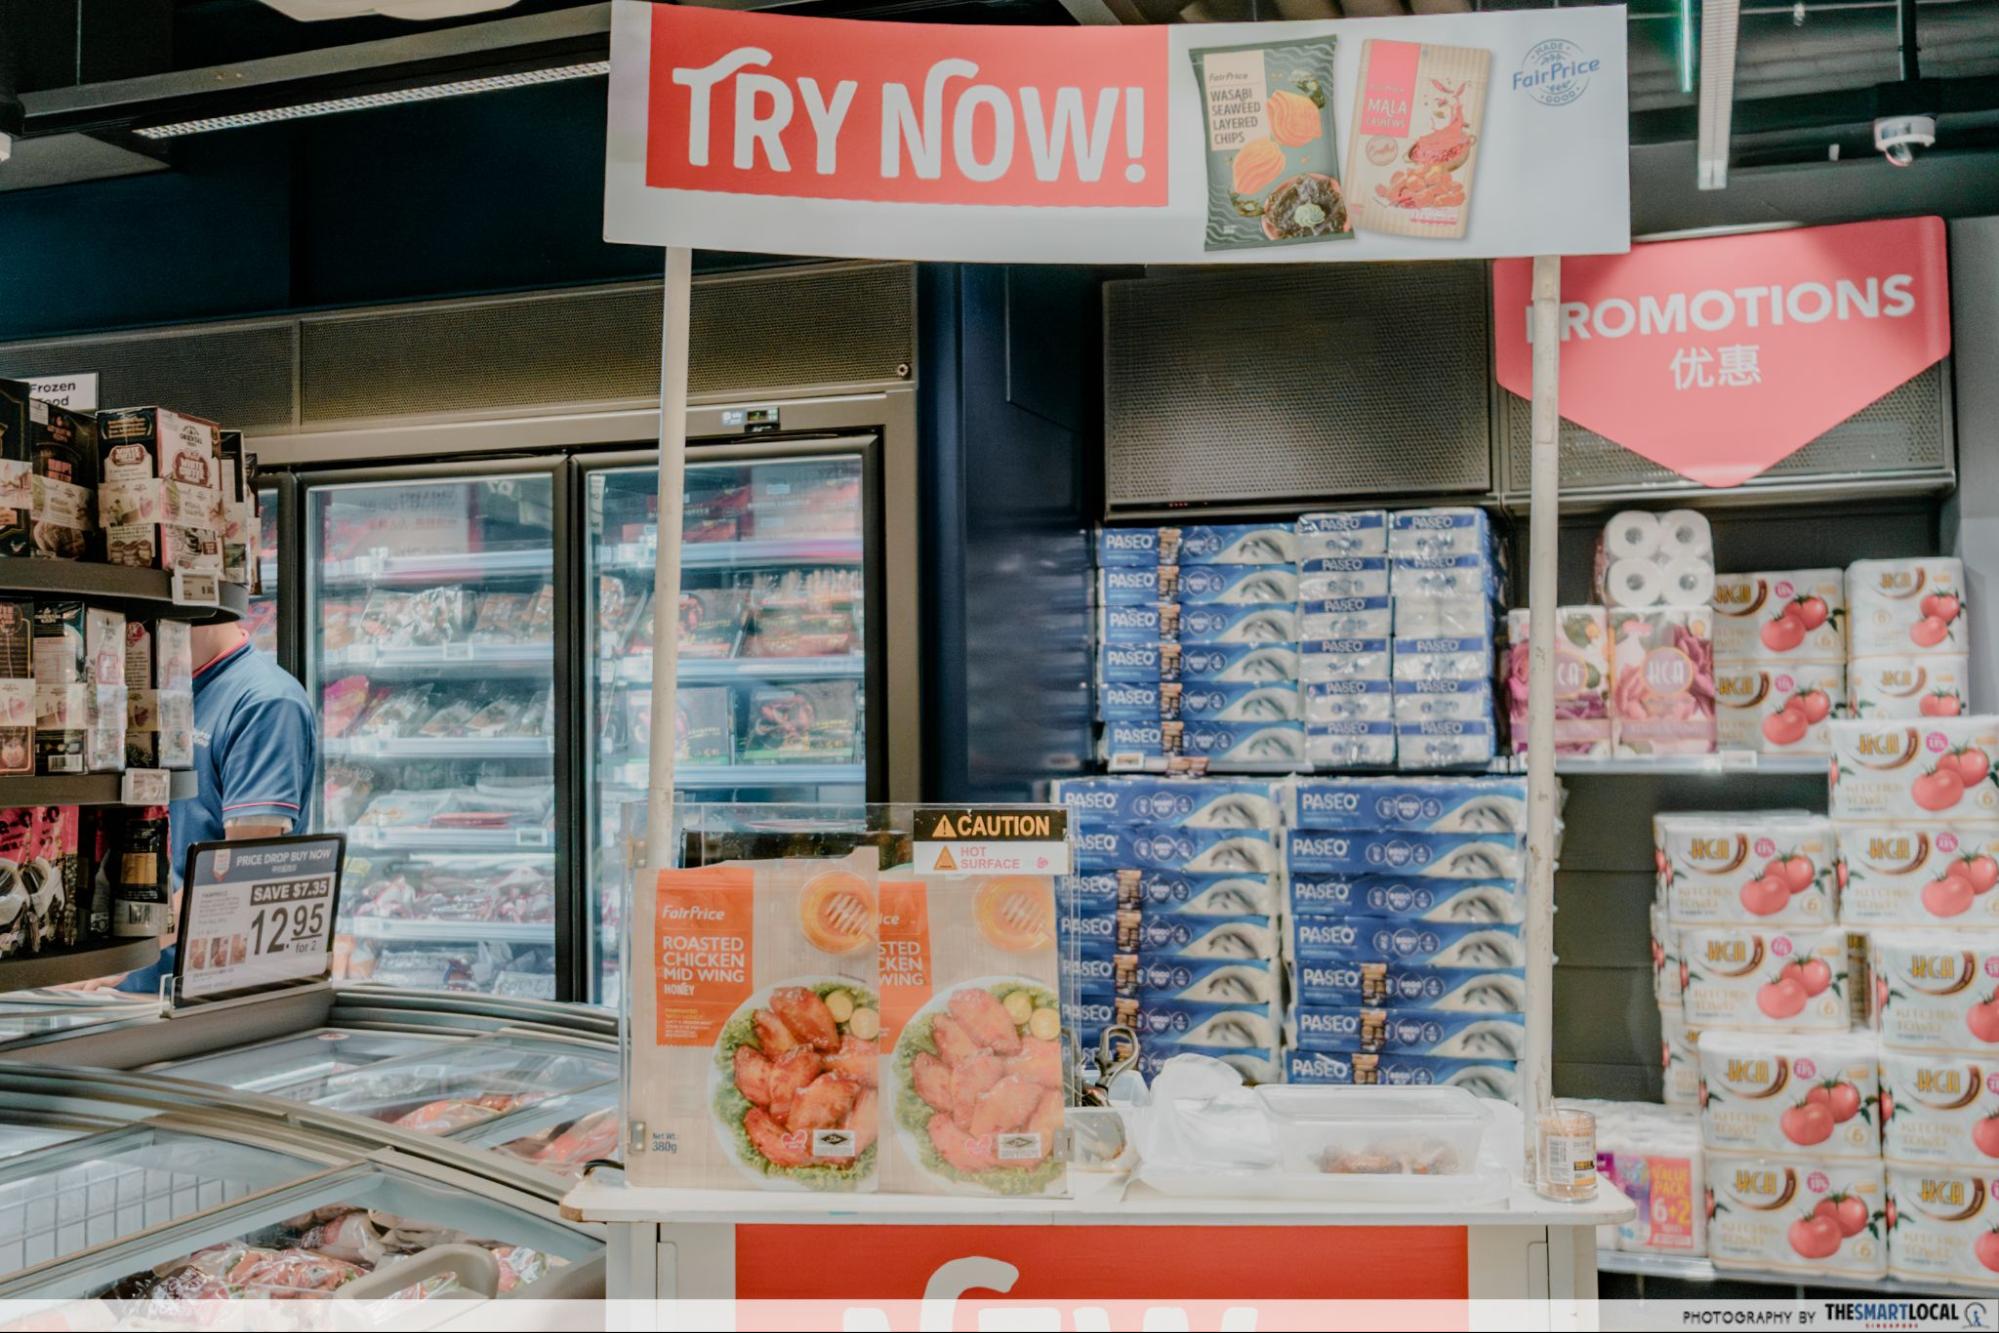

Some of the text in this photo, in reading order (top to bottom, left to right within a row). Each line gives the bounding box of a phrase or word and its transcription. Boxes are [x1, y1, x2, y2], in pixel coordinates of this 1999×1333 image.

[1535, 42, 1563, 57] MADE
[1208, 72, 1249, 82] FairPrice
[1513, 58, 1601, 91] FairPrice
[1210, 87, 1253, 102] WASABI
[1545, 90, 1576, 103] GOOD
[671, 46, 1147, 184] TRY NOW!
[1211, 102, 1261, 116] SEAWEED
[1367, 98, 1408, 118] MALA
[1212, 116, 1258, 131] LAYERED
[1214, 131, 1246, 145] CHIPS
[1669, 344, 1762, 390] 优惠
[1412, 515, 1452, 529] PASEO
[1106, 535, 1153, 550] PASEO
[1322, 558, 1363, 572] PASEO
[1108, 574, 1155, 588] PASEO
[1324, 598, 1365, 612] PASEO
[1110, 613, 1156, 628] PASEO
[1322, 640, 1363, 653] PASEO
[1416, 640, 1458, 653] PASEO
[1108, 651, 1155, 667] PASEO
[1557, 663, 1578, 686] CA
[1327, 681, 1366, 695] PASEO
[1416, 680, 1458, 694] PASEO
[1108, 690, 1155, 705] PASEO
[1327, 722, 1367, 735] PASEO
[1421, 721, 1462, 735] PASEO
[1114, 728, 1161, 744] PASEO
[1302, 792, 1358, 810] PASEO
[957, 815, 1050, 838] CAUTION
[960, 846, 987, 857] HOT
[1293, 840, 1349, 857] PASEO
[236, 848, 331, 867] PRICE DROP BUY NOW
[960, 857, 1021, 870] SURFACE
[253, 880, 328, 902] SAVE $7.35
[1295, 883, 1350, 900] PASEO
[662, 905, 725, 920] FairPrice
[1300, 927, 1355, 944] PASEO
[295, 940, 317, 953] for 2
[662, 935, 745, 952] ROASTED
[663, 951, 745, 968] CHICKEN
[663, 967, 745, 983] MID WING
[1304, 969, 1361, 987] PASEO
[664, 982, 695, 996] HONEY
[1301, 1013, 1357, 1032] PASEO
[1292, 1058, 1349, 1079] PASEO
[1852, 1128, 1863, 1143] 6
[652, 1140, 677, 1153] 380g
[1653, 1197, 1691, 1226] 6+2
